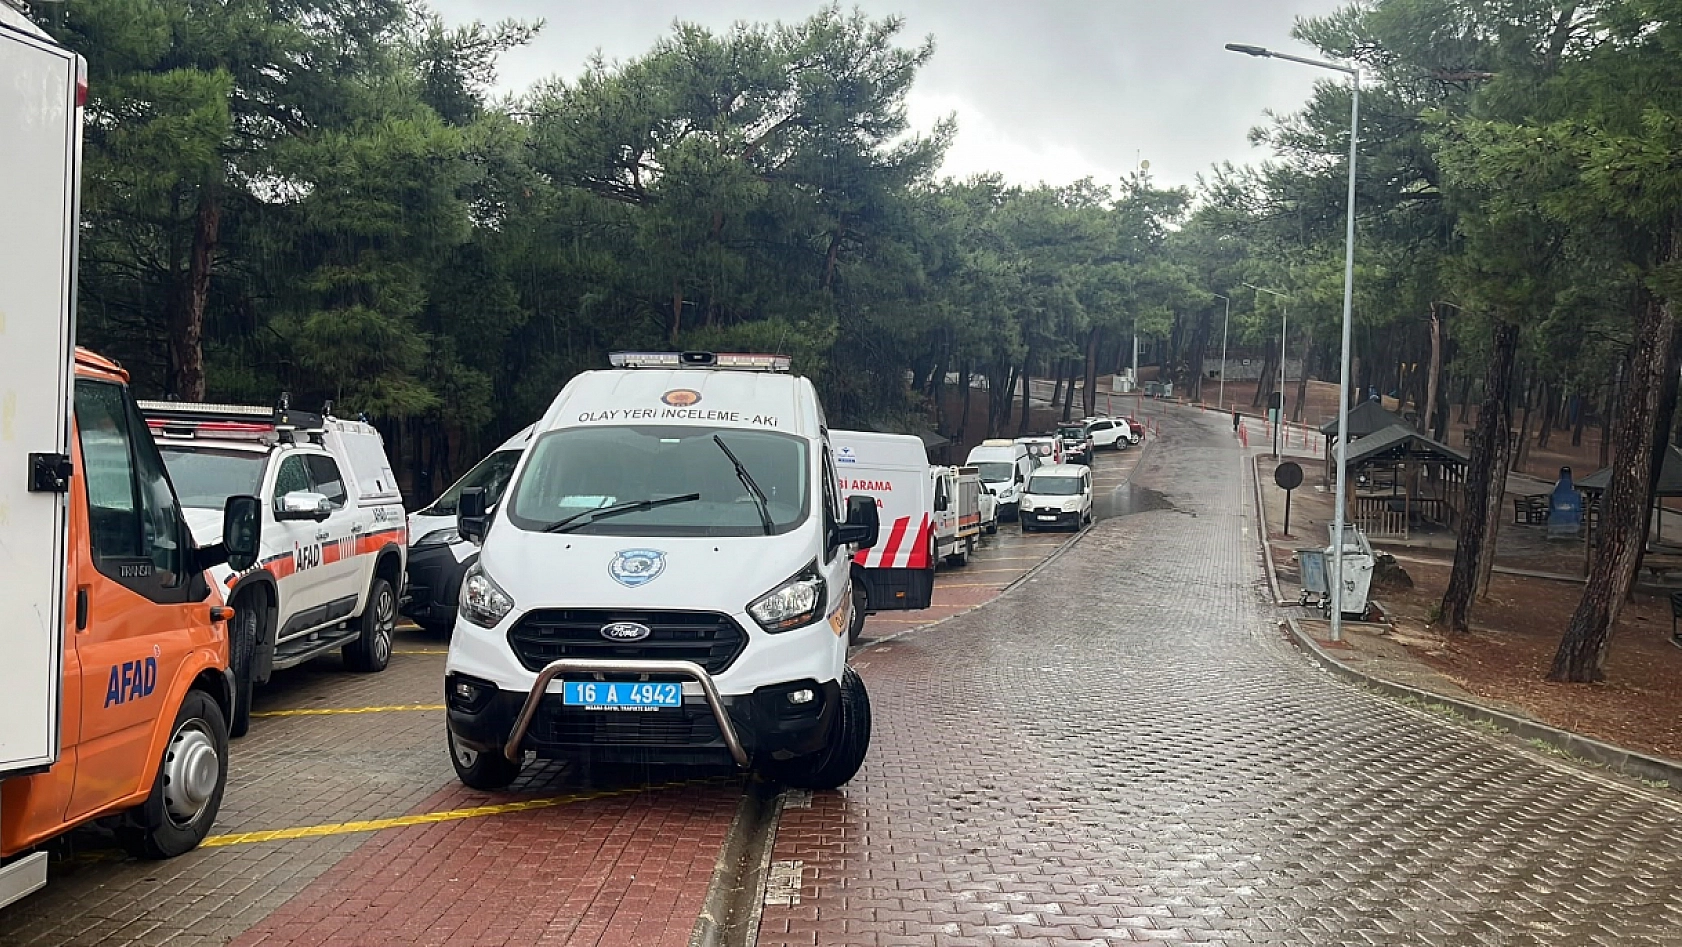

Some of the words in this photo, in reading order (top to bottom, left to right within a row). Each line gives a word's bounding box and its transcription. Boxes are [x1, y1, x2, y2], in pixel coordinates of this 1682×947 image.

[578, 409, 620, 422] OLAY
[851, 479, 892, 491] ARAMA
[295, 543, 320, 573] AFAD
[120, 564, 152, 577] TRANSIT
[610, 624, 639, 638] Ford
[103, 656, 157, 709] AFAD
[577, 683, 597, 702] 16
[607, 683, 618, 703] A
[630, 683, 676, 704] 4942
